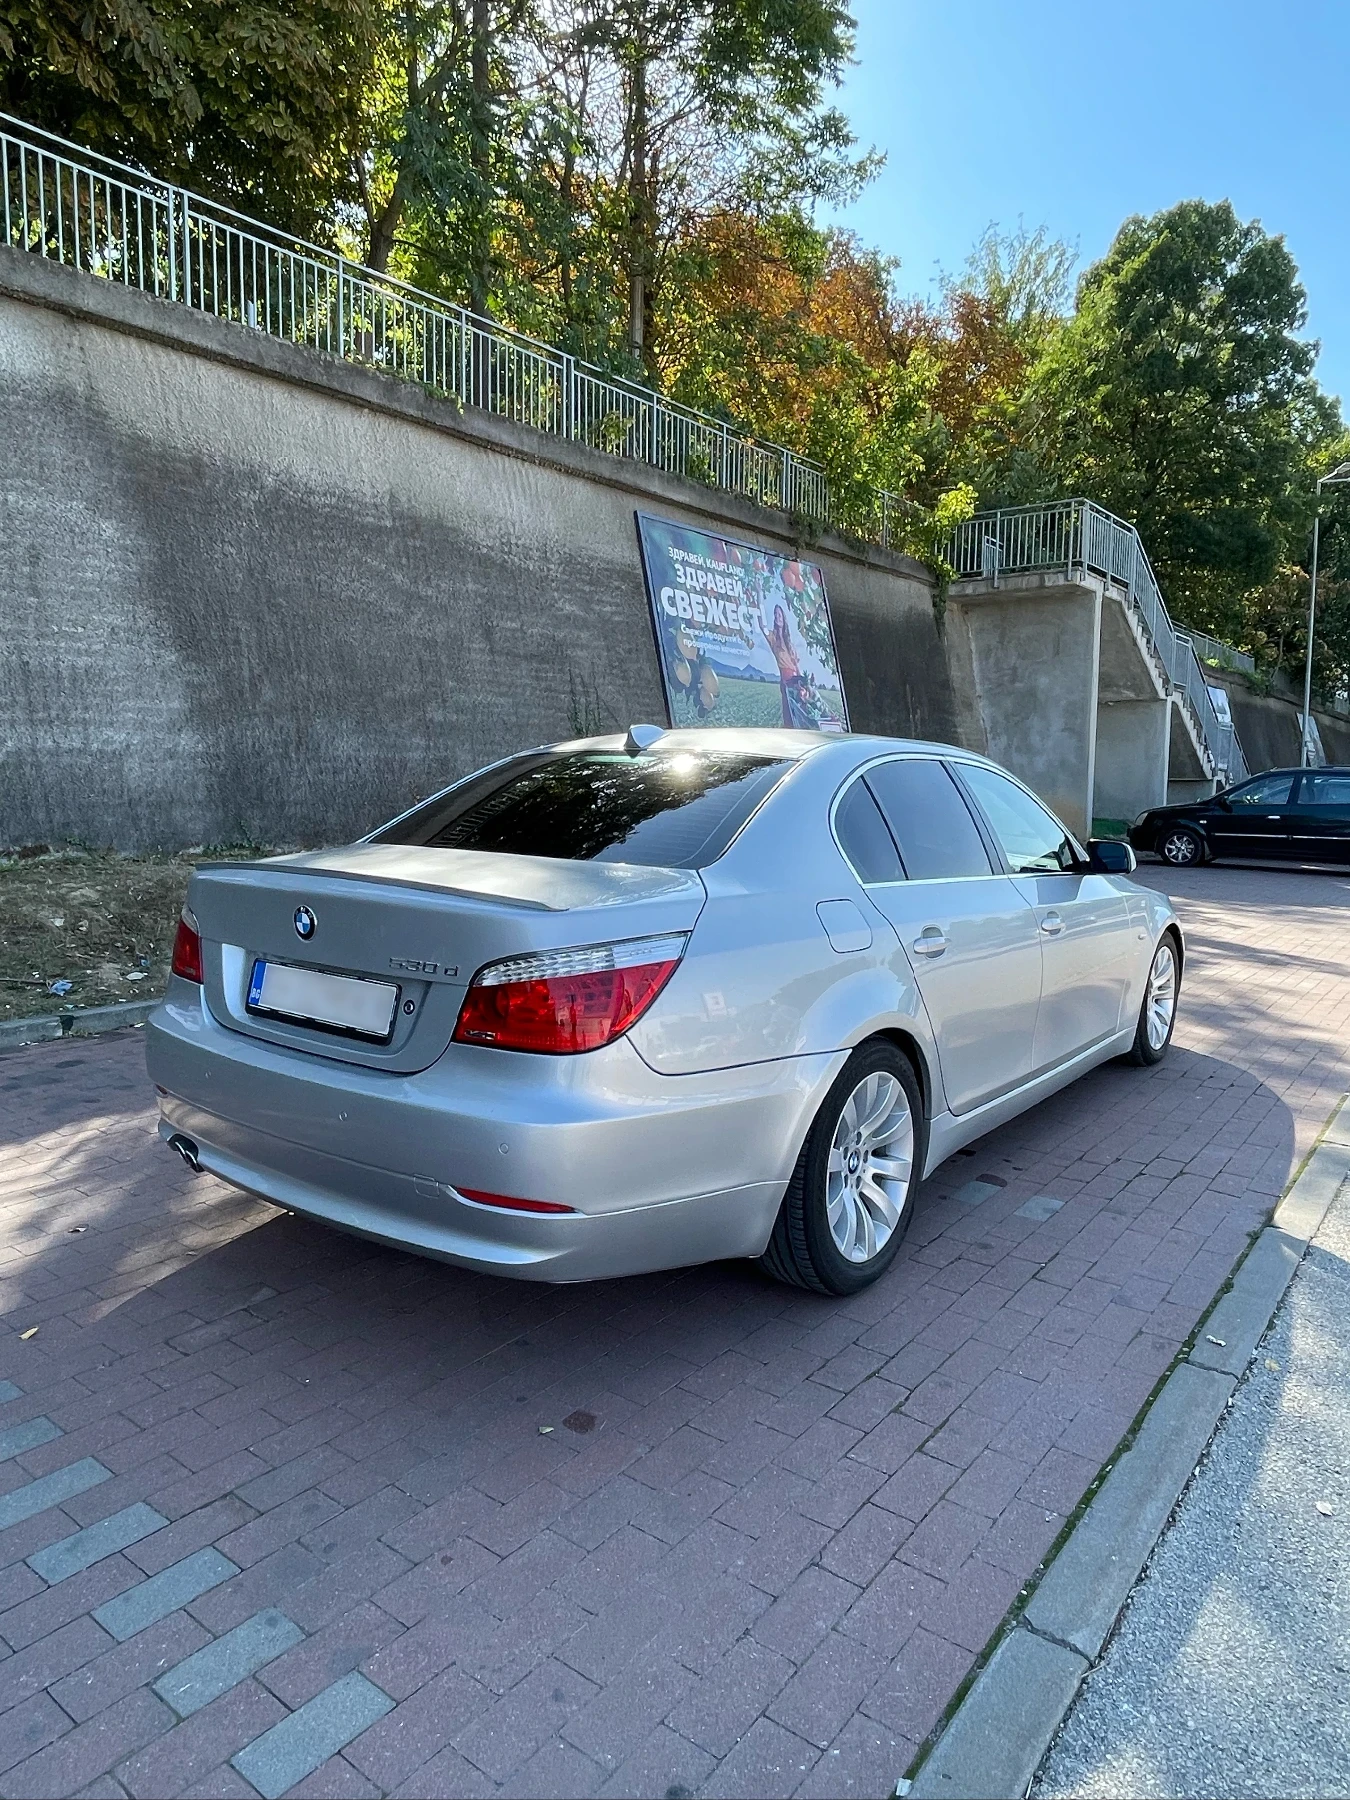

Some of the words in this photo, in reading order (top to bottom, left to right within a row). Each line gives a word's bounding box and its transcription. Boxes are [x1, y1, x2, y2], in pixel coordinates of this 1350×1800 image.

[668, 547, 706, 568] ЗДРАВЕЙ,
[674, 563, 746, 602] ЗДРАВЕЙ,
[661, 586, 770, 635] СВЕЖЕСТ!
[251, 987, 261, 999] BG
